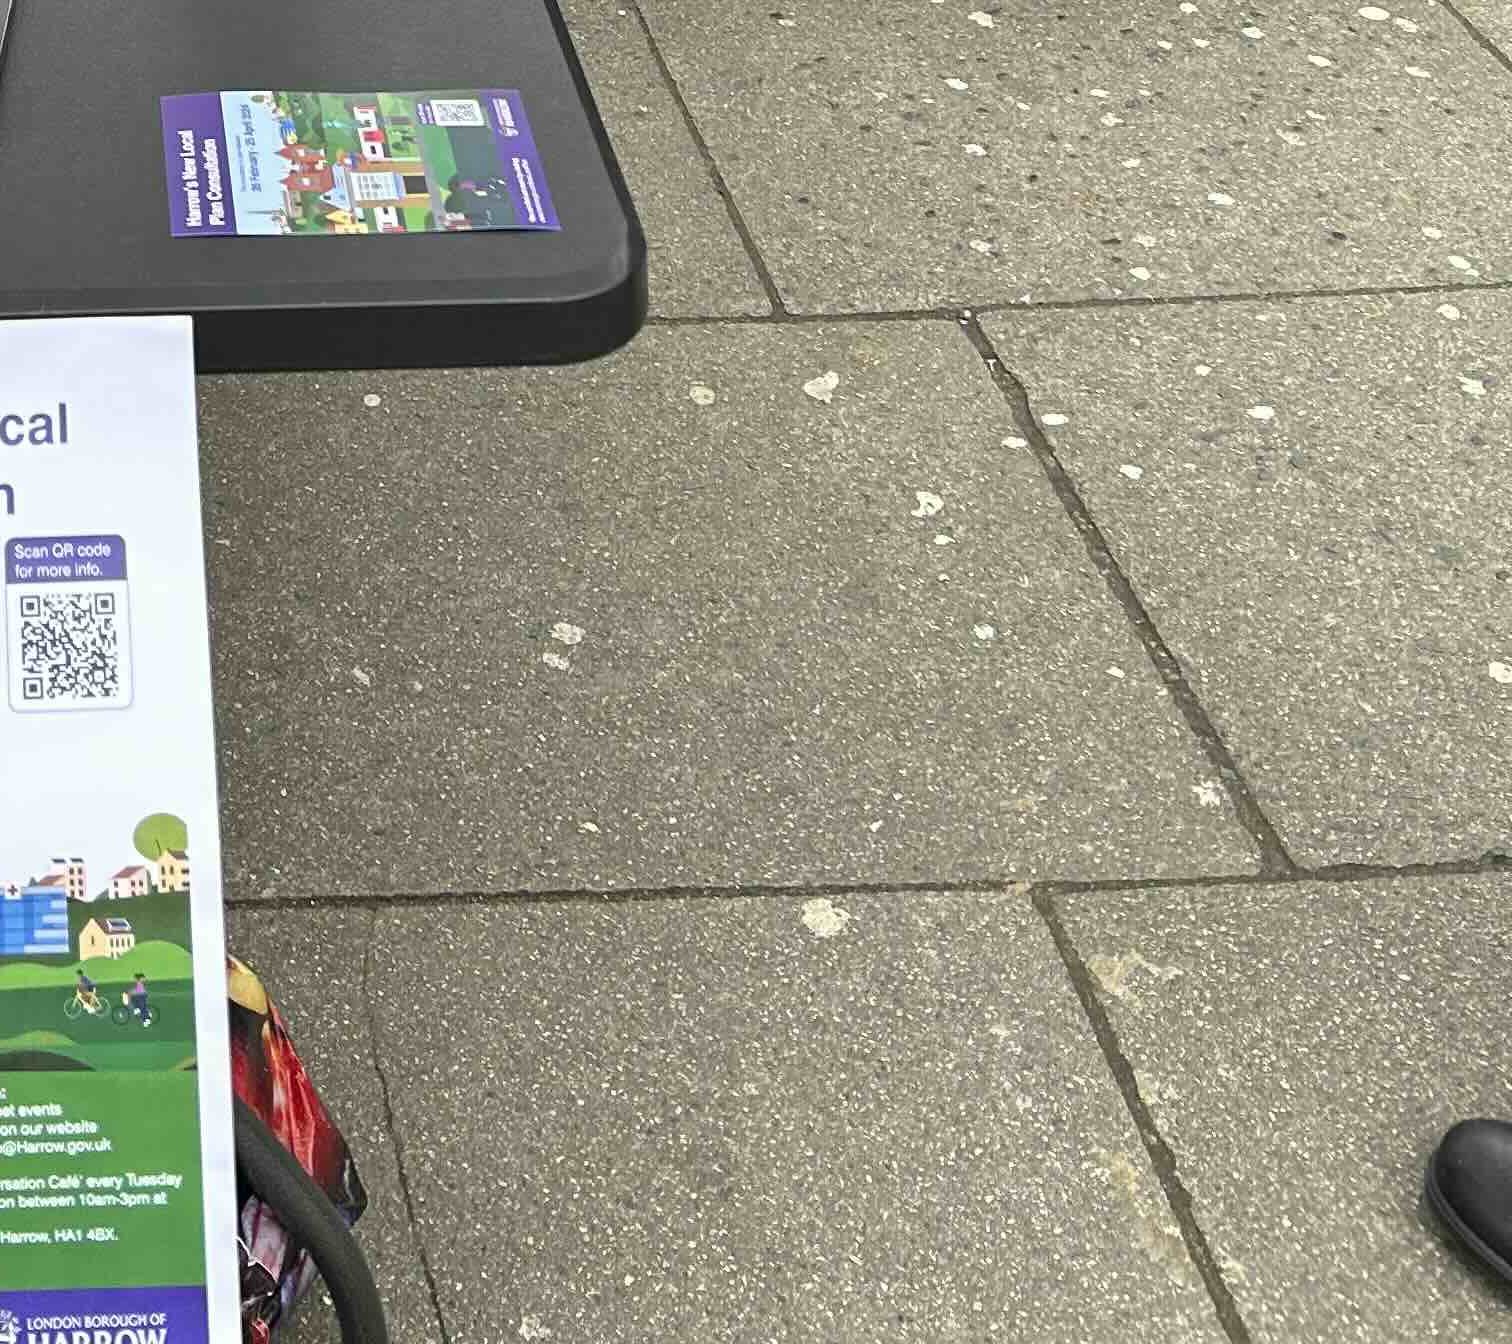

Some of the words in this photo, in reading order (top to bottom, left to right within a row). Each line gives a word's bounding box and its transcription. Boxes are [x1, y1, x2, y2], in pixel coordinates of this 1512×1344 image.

[13, 543, 50, 560] Scan
[51, 542, 75, 559] QR
[76, 541, 112, 558] code
[14, 563, 34, 580] for
[36, 564, 72, 578] more
[74, 560, 104, 577] info.
[16, 1102, 64, 1118] events
[19, 1122, 45, 1137] our
[44, 1119, 99, 1136] website
[84, 1175, 124, 1192] every
[124, 1172, 184, 1189] Tuesday
[16, 1194, 76, 1209] between
[152, 1191, 169, 1206] at
[53, 1227, 83, 1243] HA1
[26, 1315, 82, 1330] LONDON
[85, 1314, 147, 1328] BOROUGH
[149, 1313, 168, 1326] OF
